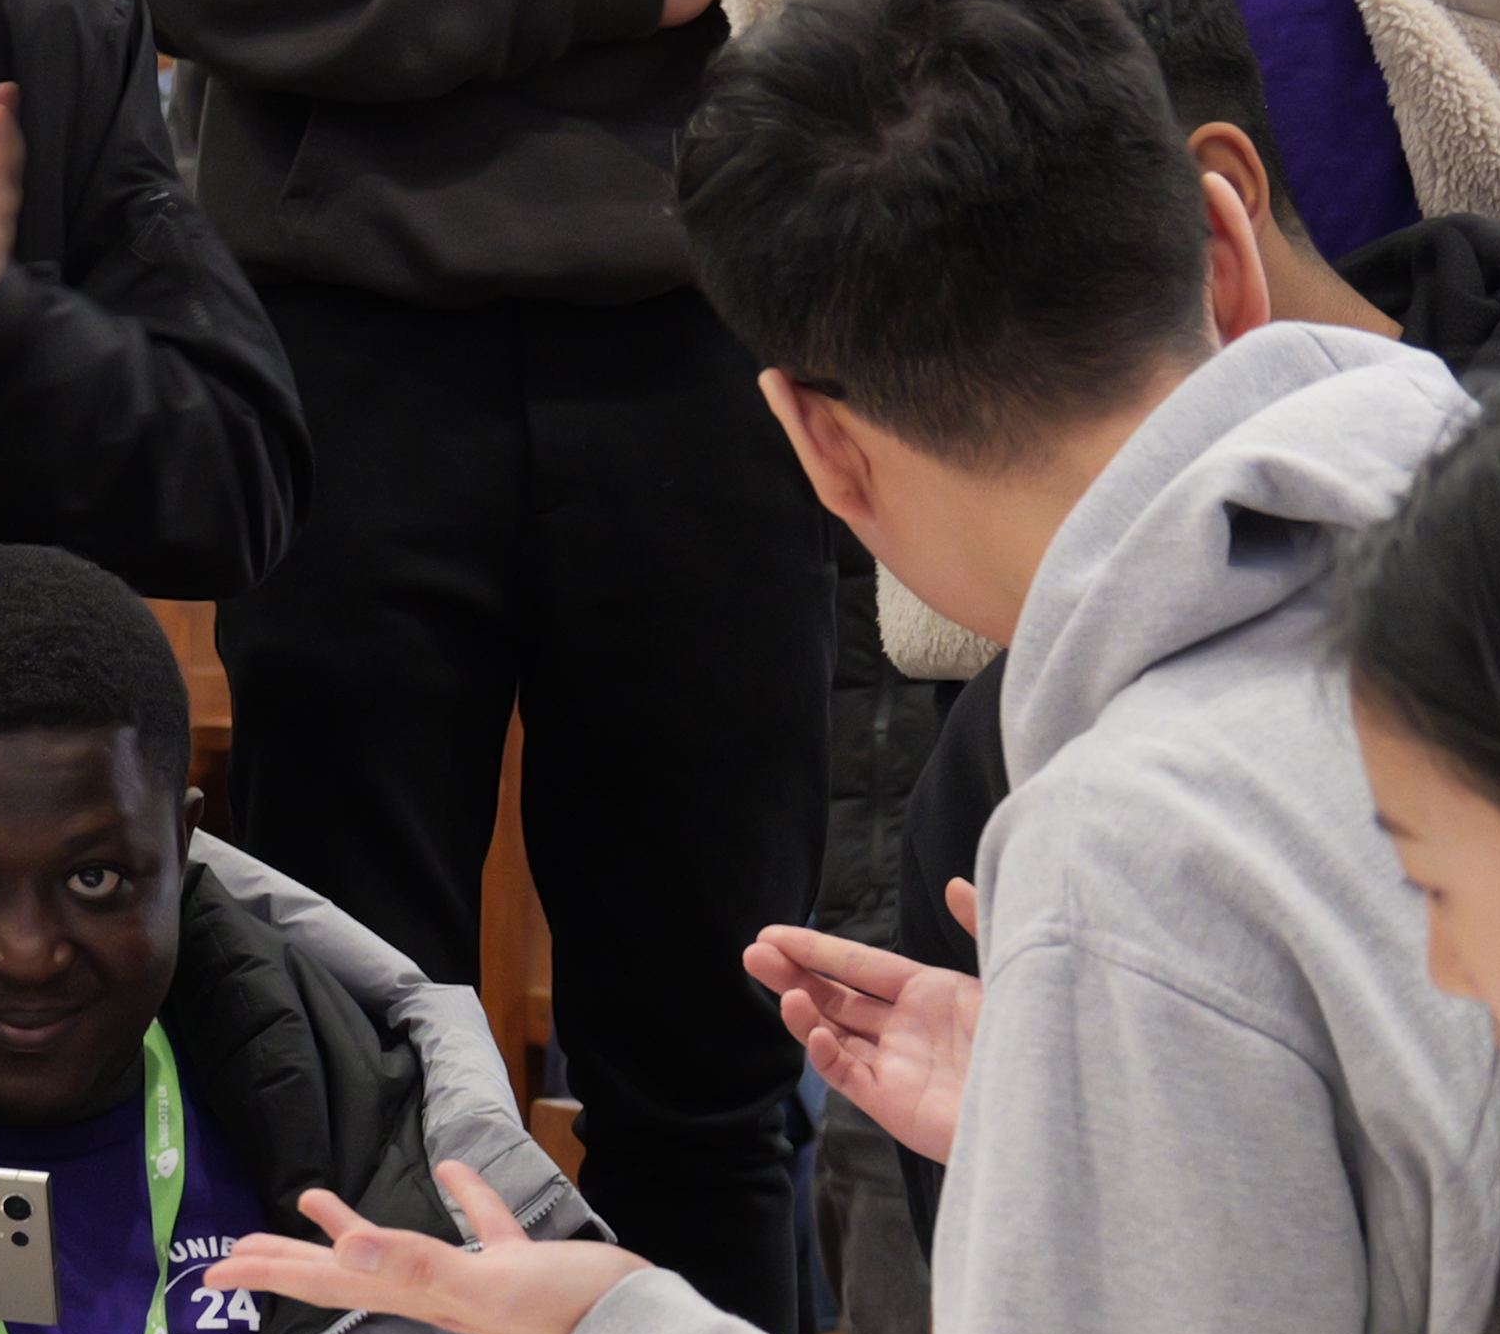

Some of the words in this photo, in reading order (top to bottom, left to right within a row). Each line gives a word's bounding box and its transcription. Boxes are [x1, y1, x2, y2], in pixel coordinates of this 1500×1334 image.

[157, 1084, 168, 1098] UK
[158, 1098, 171, 1148] UNIBOTS
[168, 1235, 240, 1264] UNIB
[190, 1286, 262, 1332] 24
